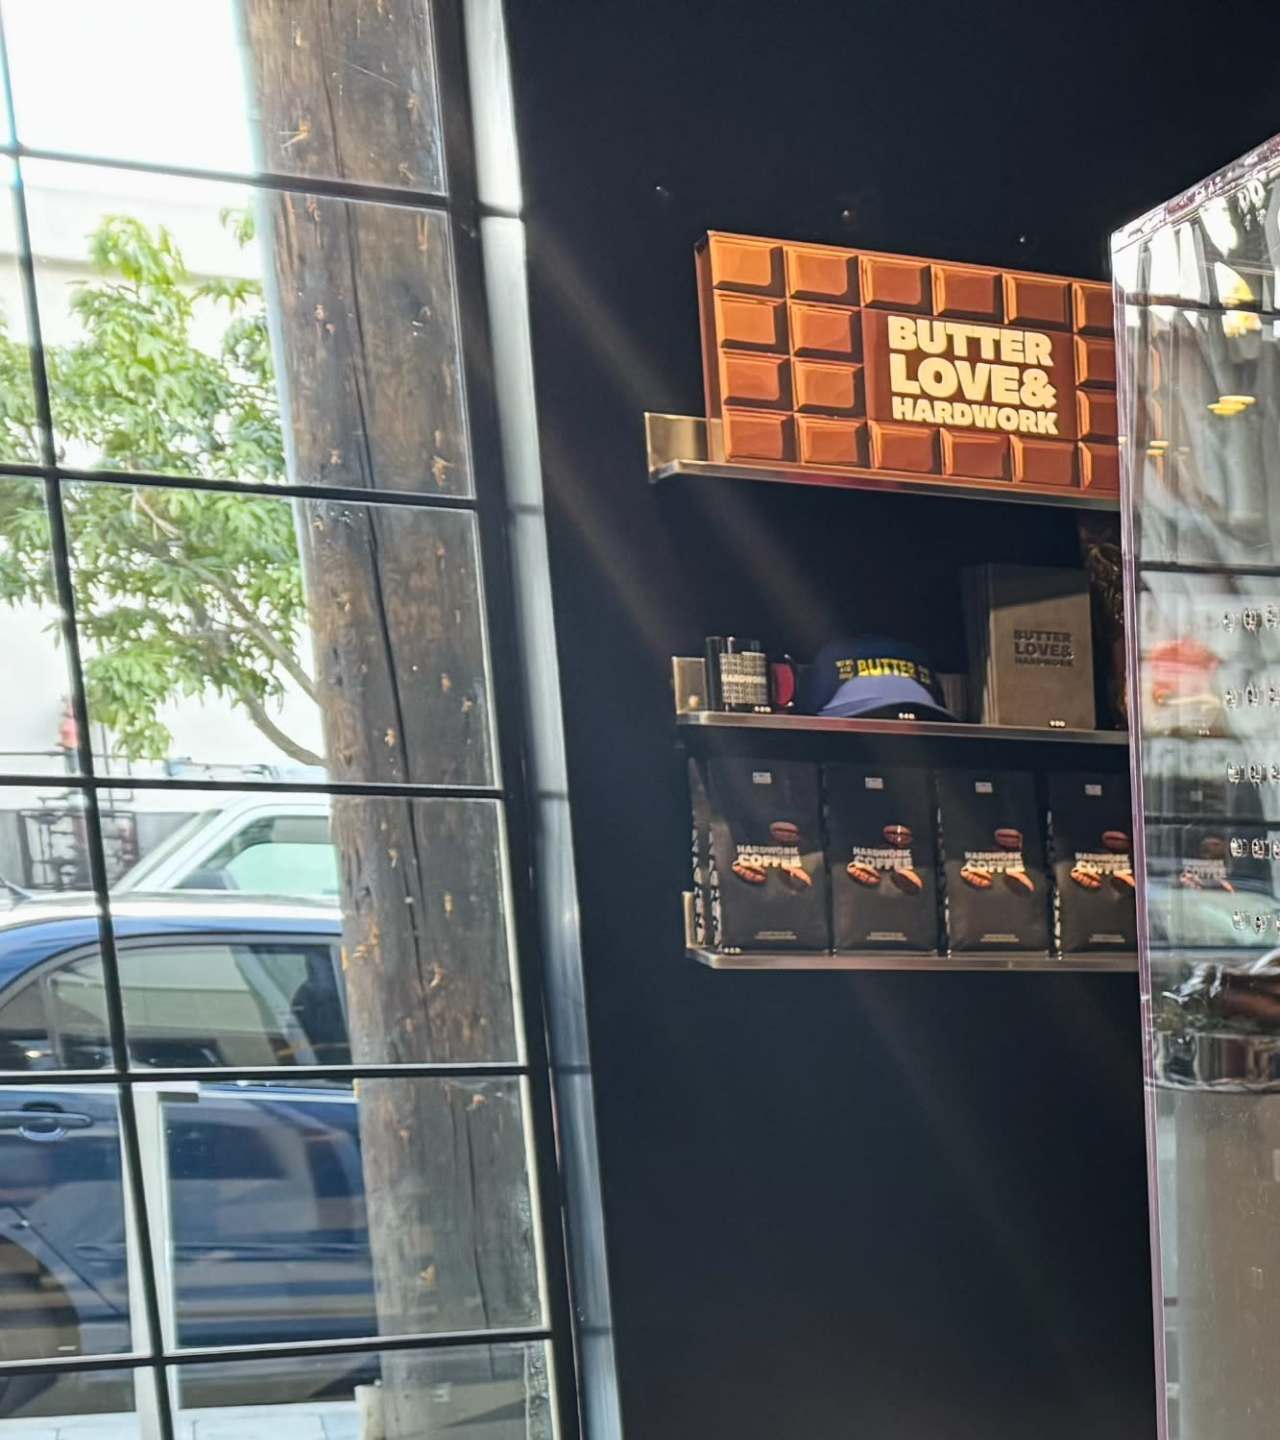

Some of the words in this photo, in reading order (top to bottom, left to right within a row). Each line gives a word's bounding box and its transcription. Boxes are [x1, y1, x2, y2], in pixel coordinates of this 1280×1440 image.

[888, 315, 1054, 367] BUTTER
[889, 352, 1057, 409] LOVE&
[891, 396, 1059, 435] HARDWORK
[1013, 629, 1072, 643] BUTTER
[1014, 641, 1073, 658] LOVE&
[857, 657, 916, 678] BUTTER
[736, 844, 799, 855] HARDWORK
[852, 846, 912, 857] HARDWORK
[737, 854, 803, 869] COFFEE
[853, 856, 914, 870] COFFEE
[965, 859, 1025, 874] COFFEE
